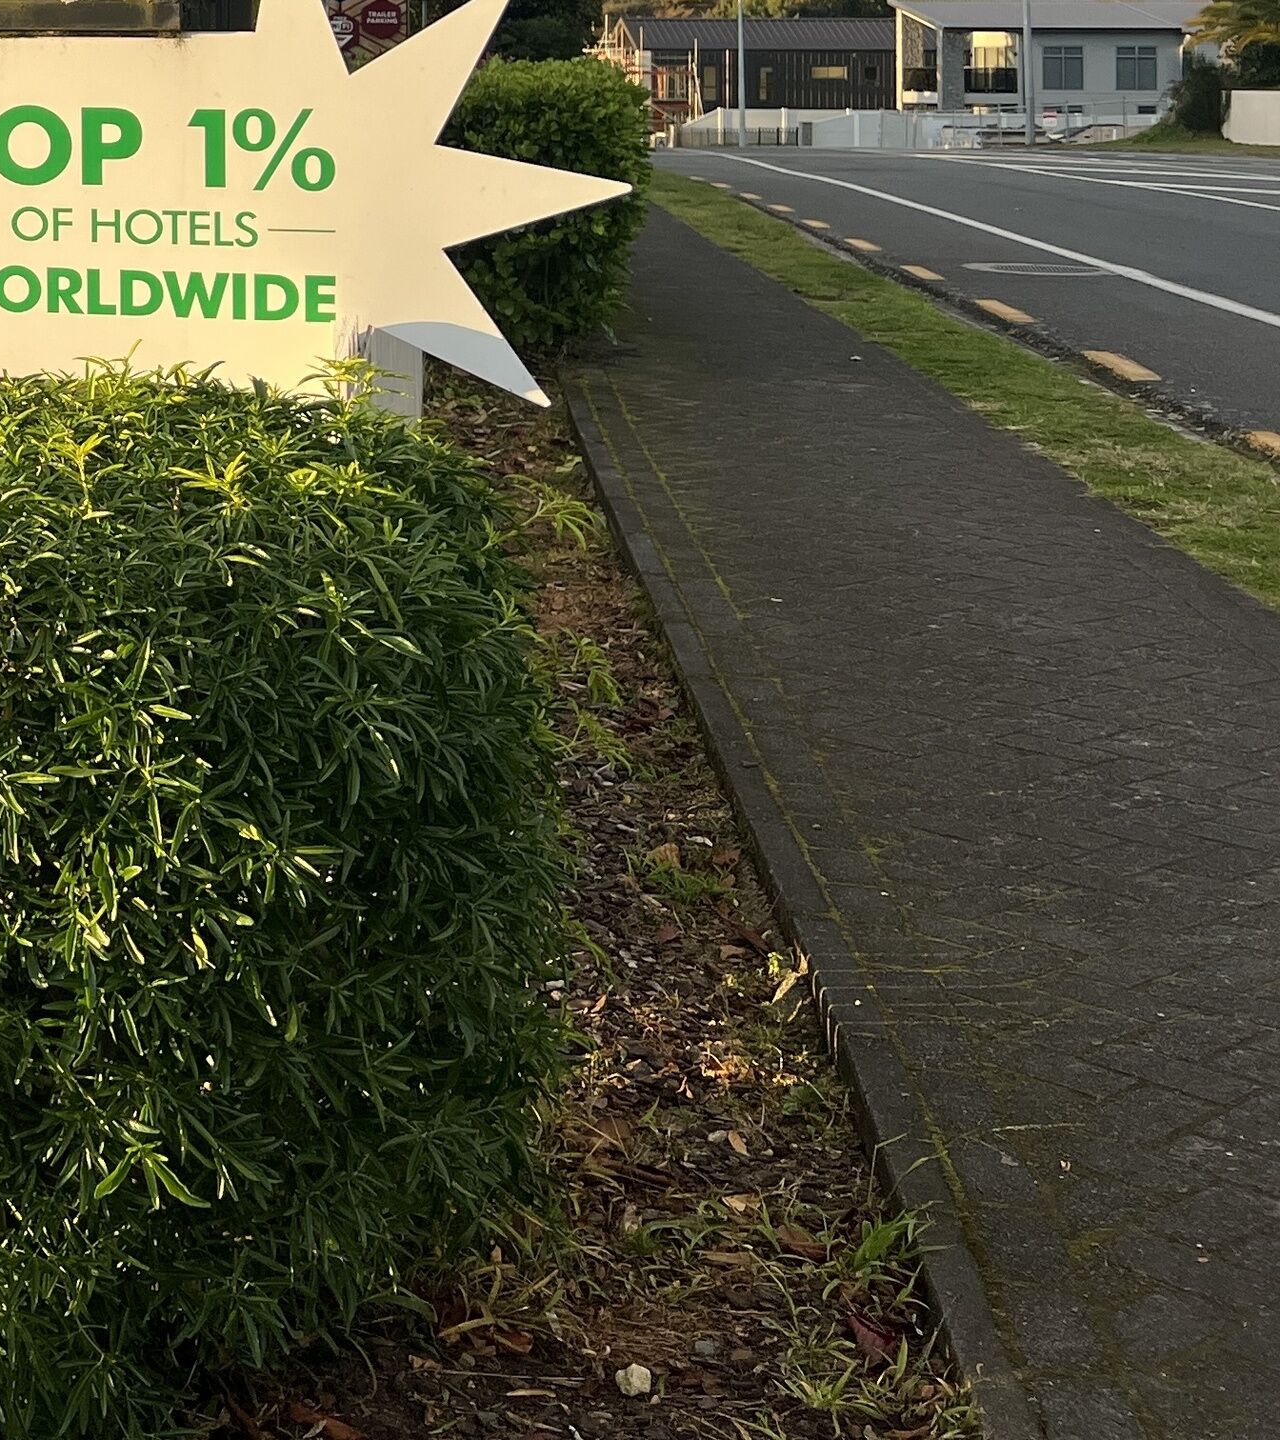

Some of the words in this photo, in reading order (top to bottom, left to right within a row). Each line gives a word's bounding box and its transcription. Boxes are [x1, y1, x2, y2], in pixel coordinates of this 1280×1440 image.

[187, 107, 336, 192] 1%
[10, 205, 74, 242] OF
[90, 208, 259, 248] HOTELS
